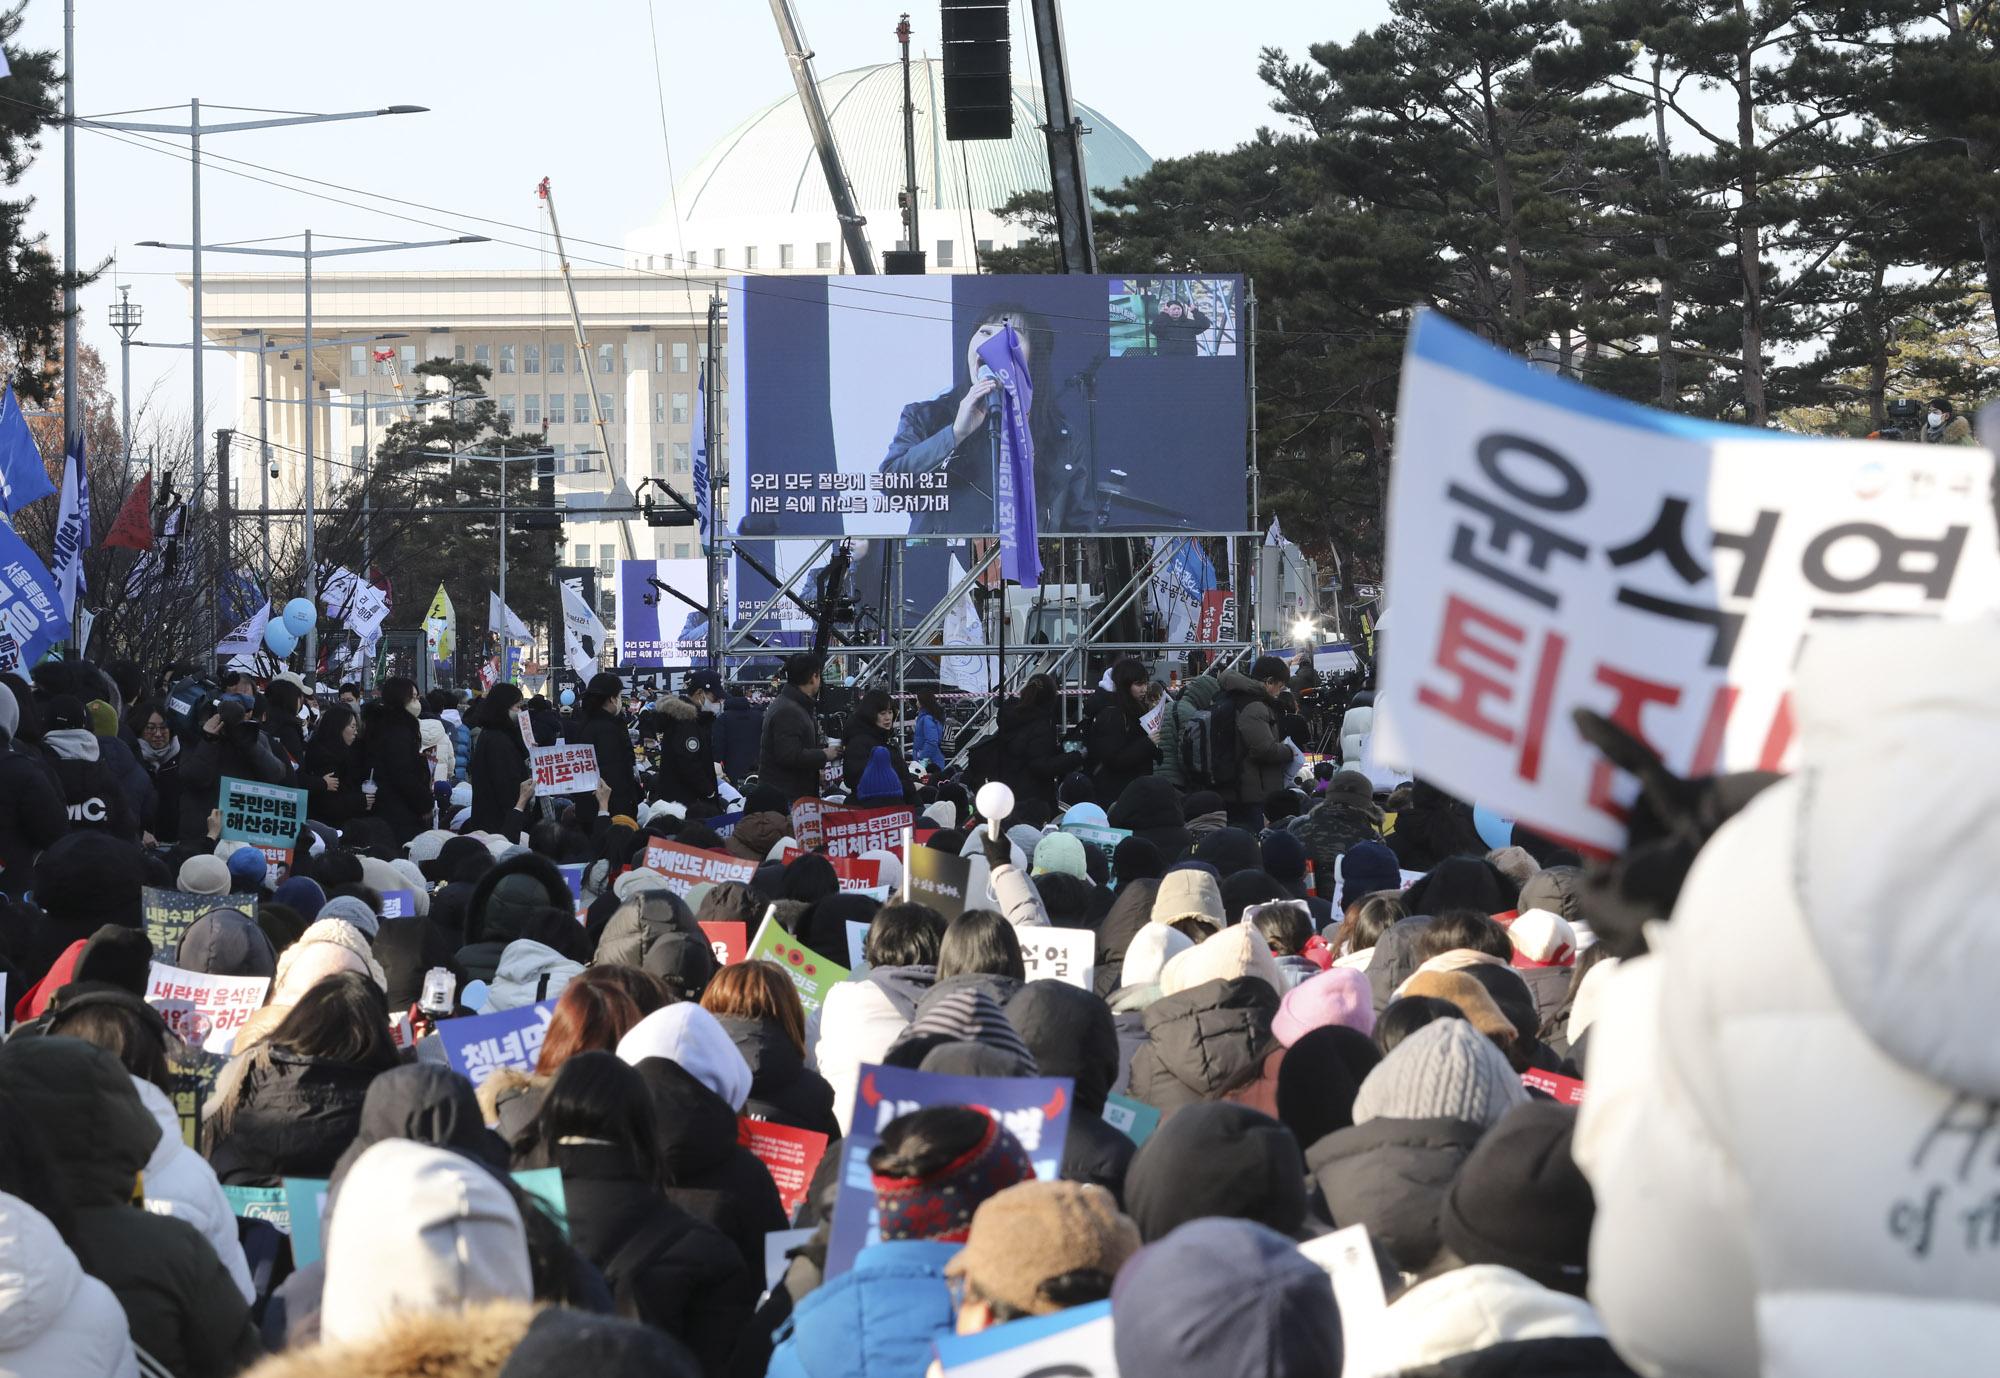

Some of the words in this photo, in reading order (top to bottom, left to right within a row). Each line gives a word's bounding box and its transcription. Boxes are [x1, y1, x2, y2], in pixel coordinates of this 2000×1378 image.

[751, 473, 779, 490] 우리
[785, 473, 812, 490] 모두
[818, 473, 865, 490] 절망에
[870, 473, 914, 490] 굴하지
[919, 472, 948, 489] 않고
[751, 496, 779, 513] 시련
[785, 496, 815, 513] 속에
[822, 496, 867, 513] 자신을
[873, 495, 949, 513] 깨우쳐가며
[3, 560, 58, 623] 서울특별시
[534, 753, 563, 766] 내란범
[566, 748, 593, 761] 윤석열
[536, 760, 597, 786] 체포하라
[229, 792, 297, 819] 국민의힘
[226, 812, 297, 839] 해산하라
[826, 822, 867, 837] 내란동조
[871, 812, 910, 830] 국민의힘
[647, 846, 703, 877] 장애인도
[702, 859, 754, 884] 시민으로
[145, 906, 195, 923] 내란수괴
[154, 981, 211, 1006] 내란범
